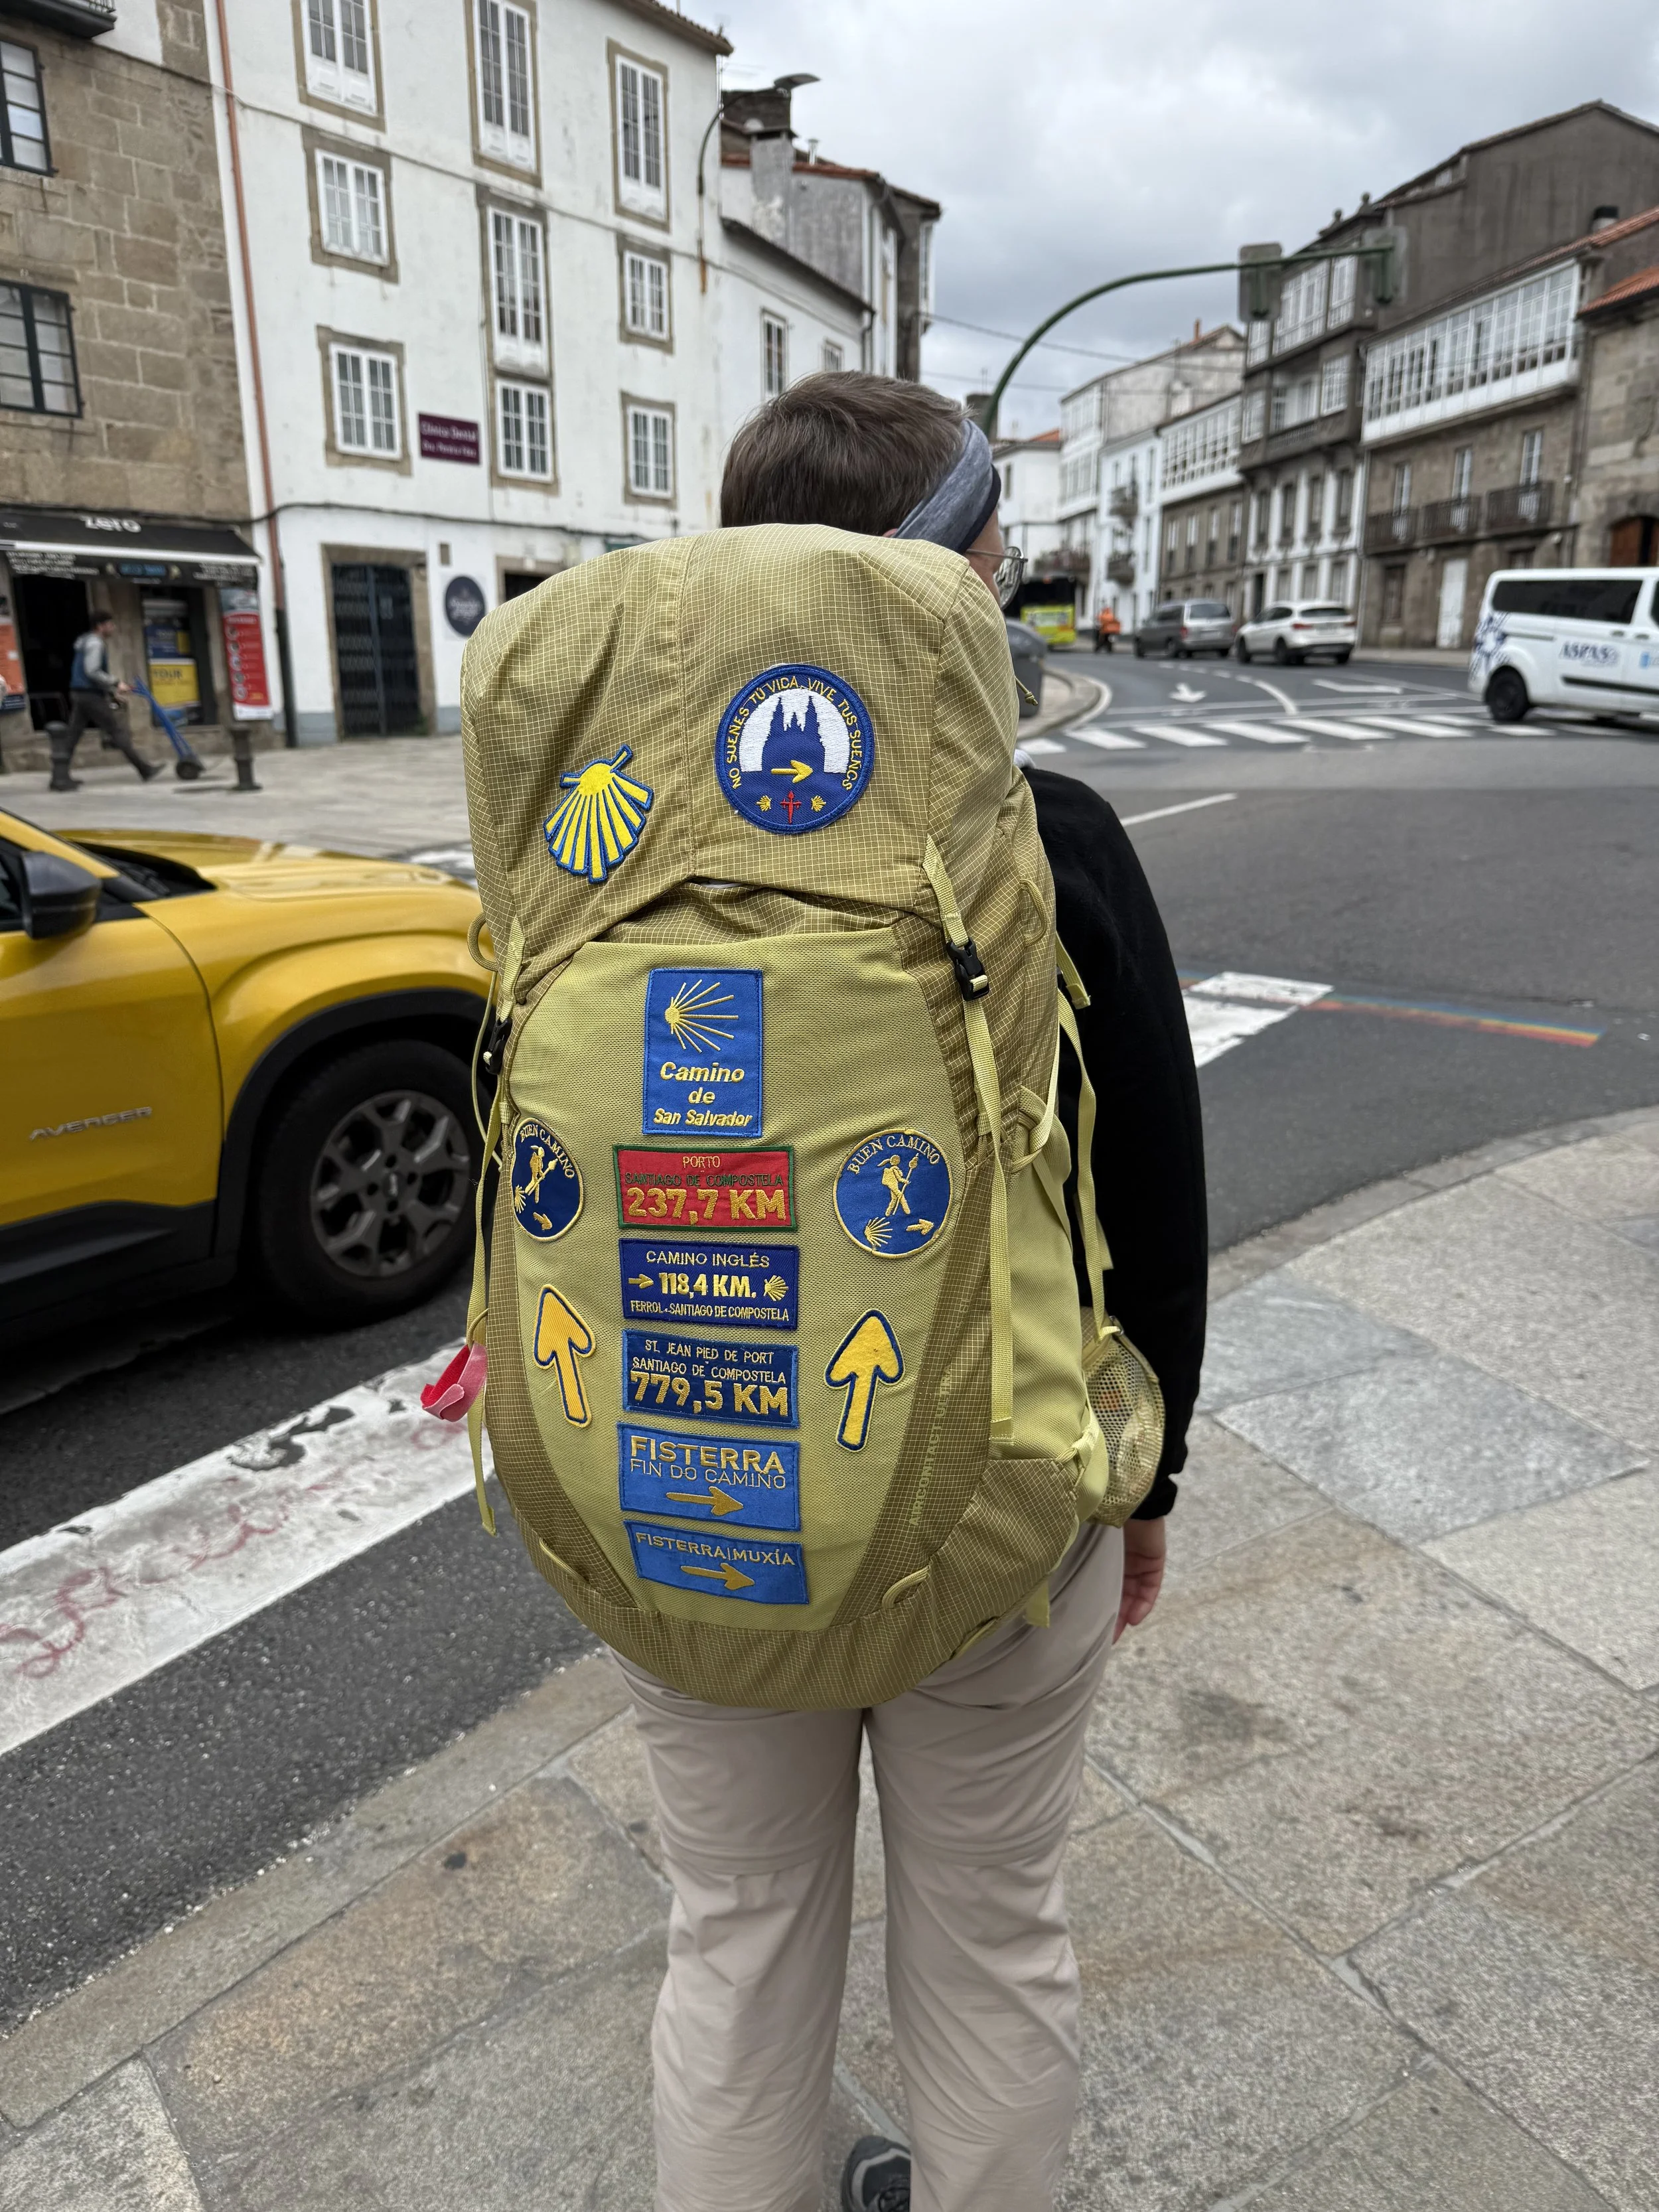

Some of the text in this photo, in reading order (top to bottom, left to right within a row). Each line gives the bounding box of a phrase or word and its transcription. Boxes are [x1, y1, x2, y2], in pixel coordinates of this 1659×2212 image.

[729, 768, 741, 789] NO
[808, 678, 836, 701] VIVE
[838, 699, 857, 725] TUS
[660, 1062, 745, 1082] Camino
[688, 1087, 715, 1104] de
[29, 1106, 152, 1140] AVENGER
[654, 1108, 753, 1127] San Salvador
[520, 1124, 575, 1179] BUEN CAMINO
[683, 1156, 720, 1168] PORTO
[847, 1134, 940, 1175] BUEN CAMINO
[624, 1173, 783, 1187] SANTIAGO DE COMPOSTELA
[627, 1187, 786, 1225] 237,7 KM
[646, 1250, 770, 1268] CAMINO INGLÉS
[658, 1272, 757, 1299] 118,4 KM.
[714, 1305, 727, 1318] DE
[728, 1306, 790, 1321] COMPOSTELA
[645, 1339, 774, 1364] ST. JEAN PIED DE PORT
[632, 1357, 786, 1384] SANTIAGO DE COMPOSTELA
[630, 1370, 788, 1417] 779,5 KM
[630, 1435, 786, 1475] FISTERRA
[908, 1364, 952, 1526] AIRCONTACT ULTRA
[630, 1458, 786, 1489] FIN DO CAMINO
